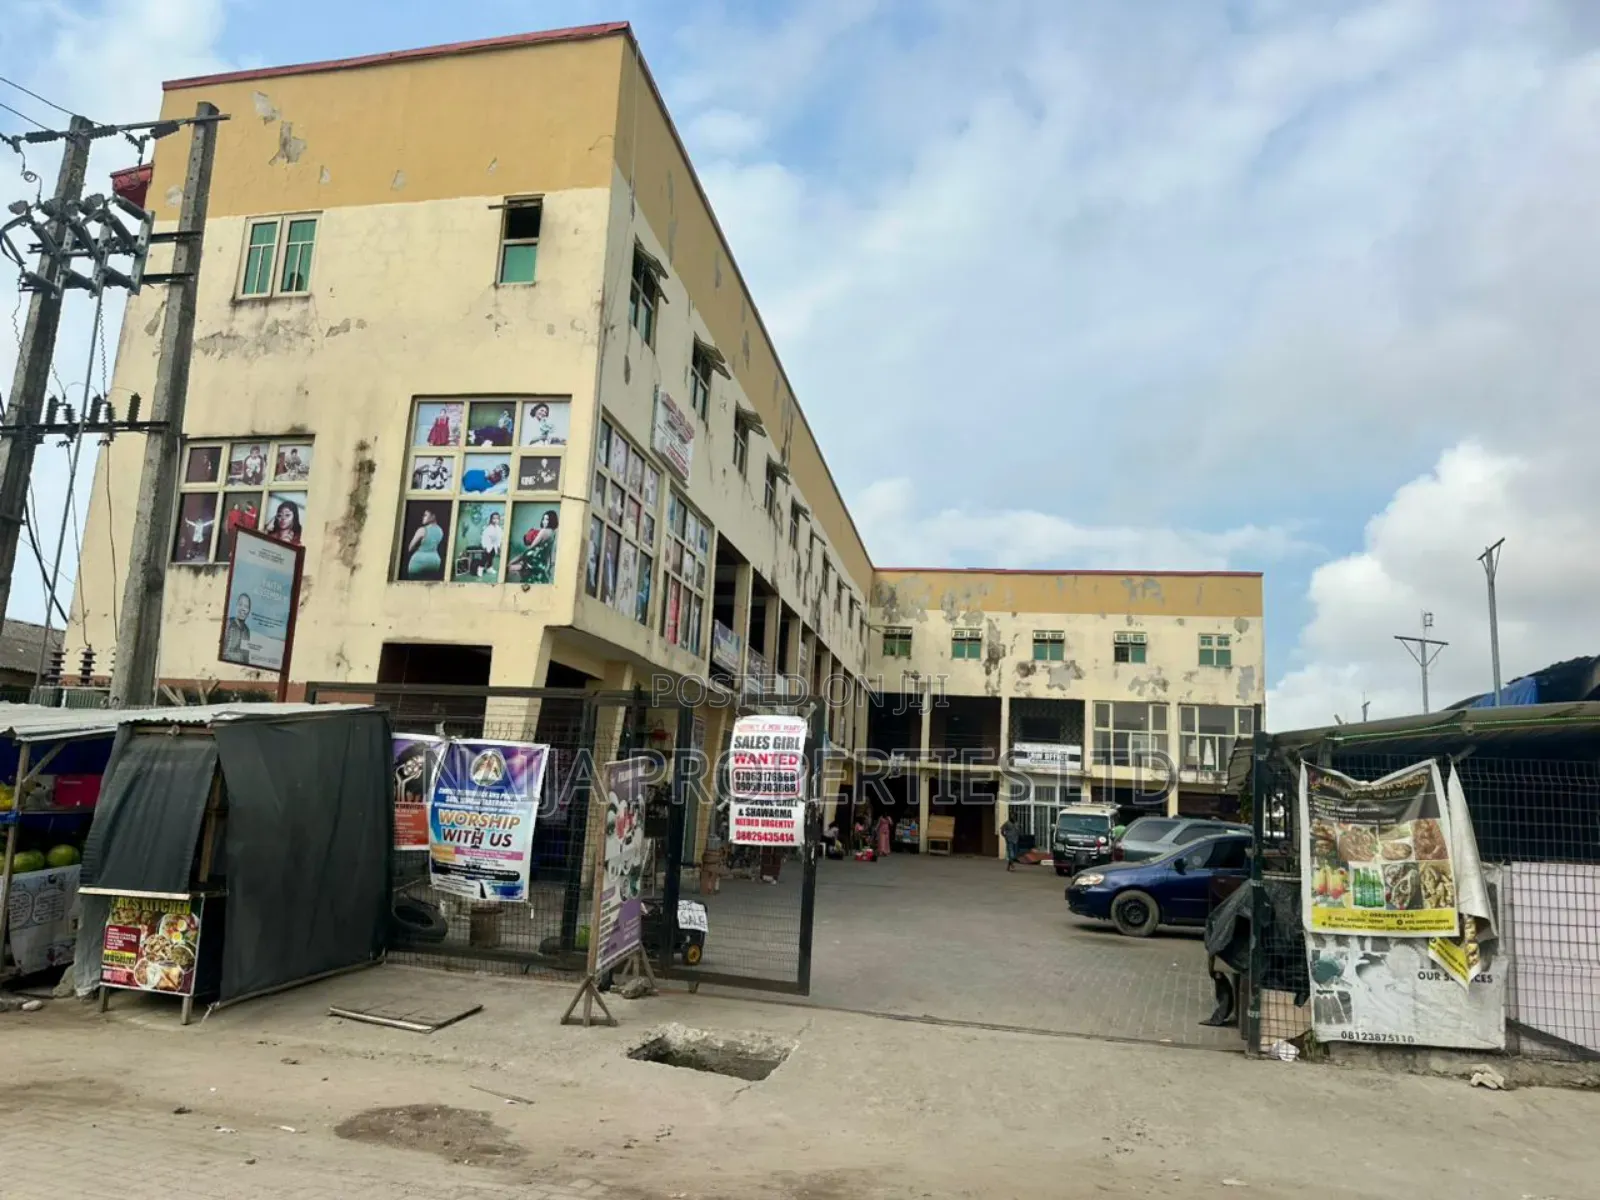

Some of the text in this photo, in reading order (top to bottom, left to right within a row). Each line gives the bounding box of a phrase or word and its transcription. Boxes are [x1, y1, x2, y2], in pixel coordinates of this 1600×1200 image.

[734, 735, 801, 750] SALES GIRL
[734, 752, 798, 766] WANTED
[438, 809, 521, 830] WORSHIP
[745, 808, 793, 819] SHAWARMA
[761, 819, 795, 829] URGENTLY
[443, 828, 513, 847] WITH US
[142, 898, 191, 915] KITCHEN
[1417, 971, 1493, 984] OUR SCES
